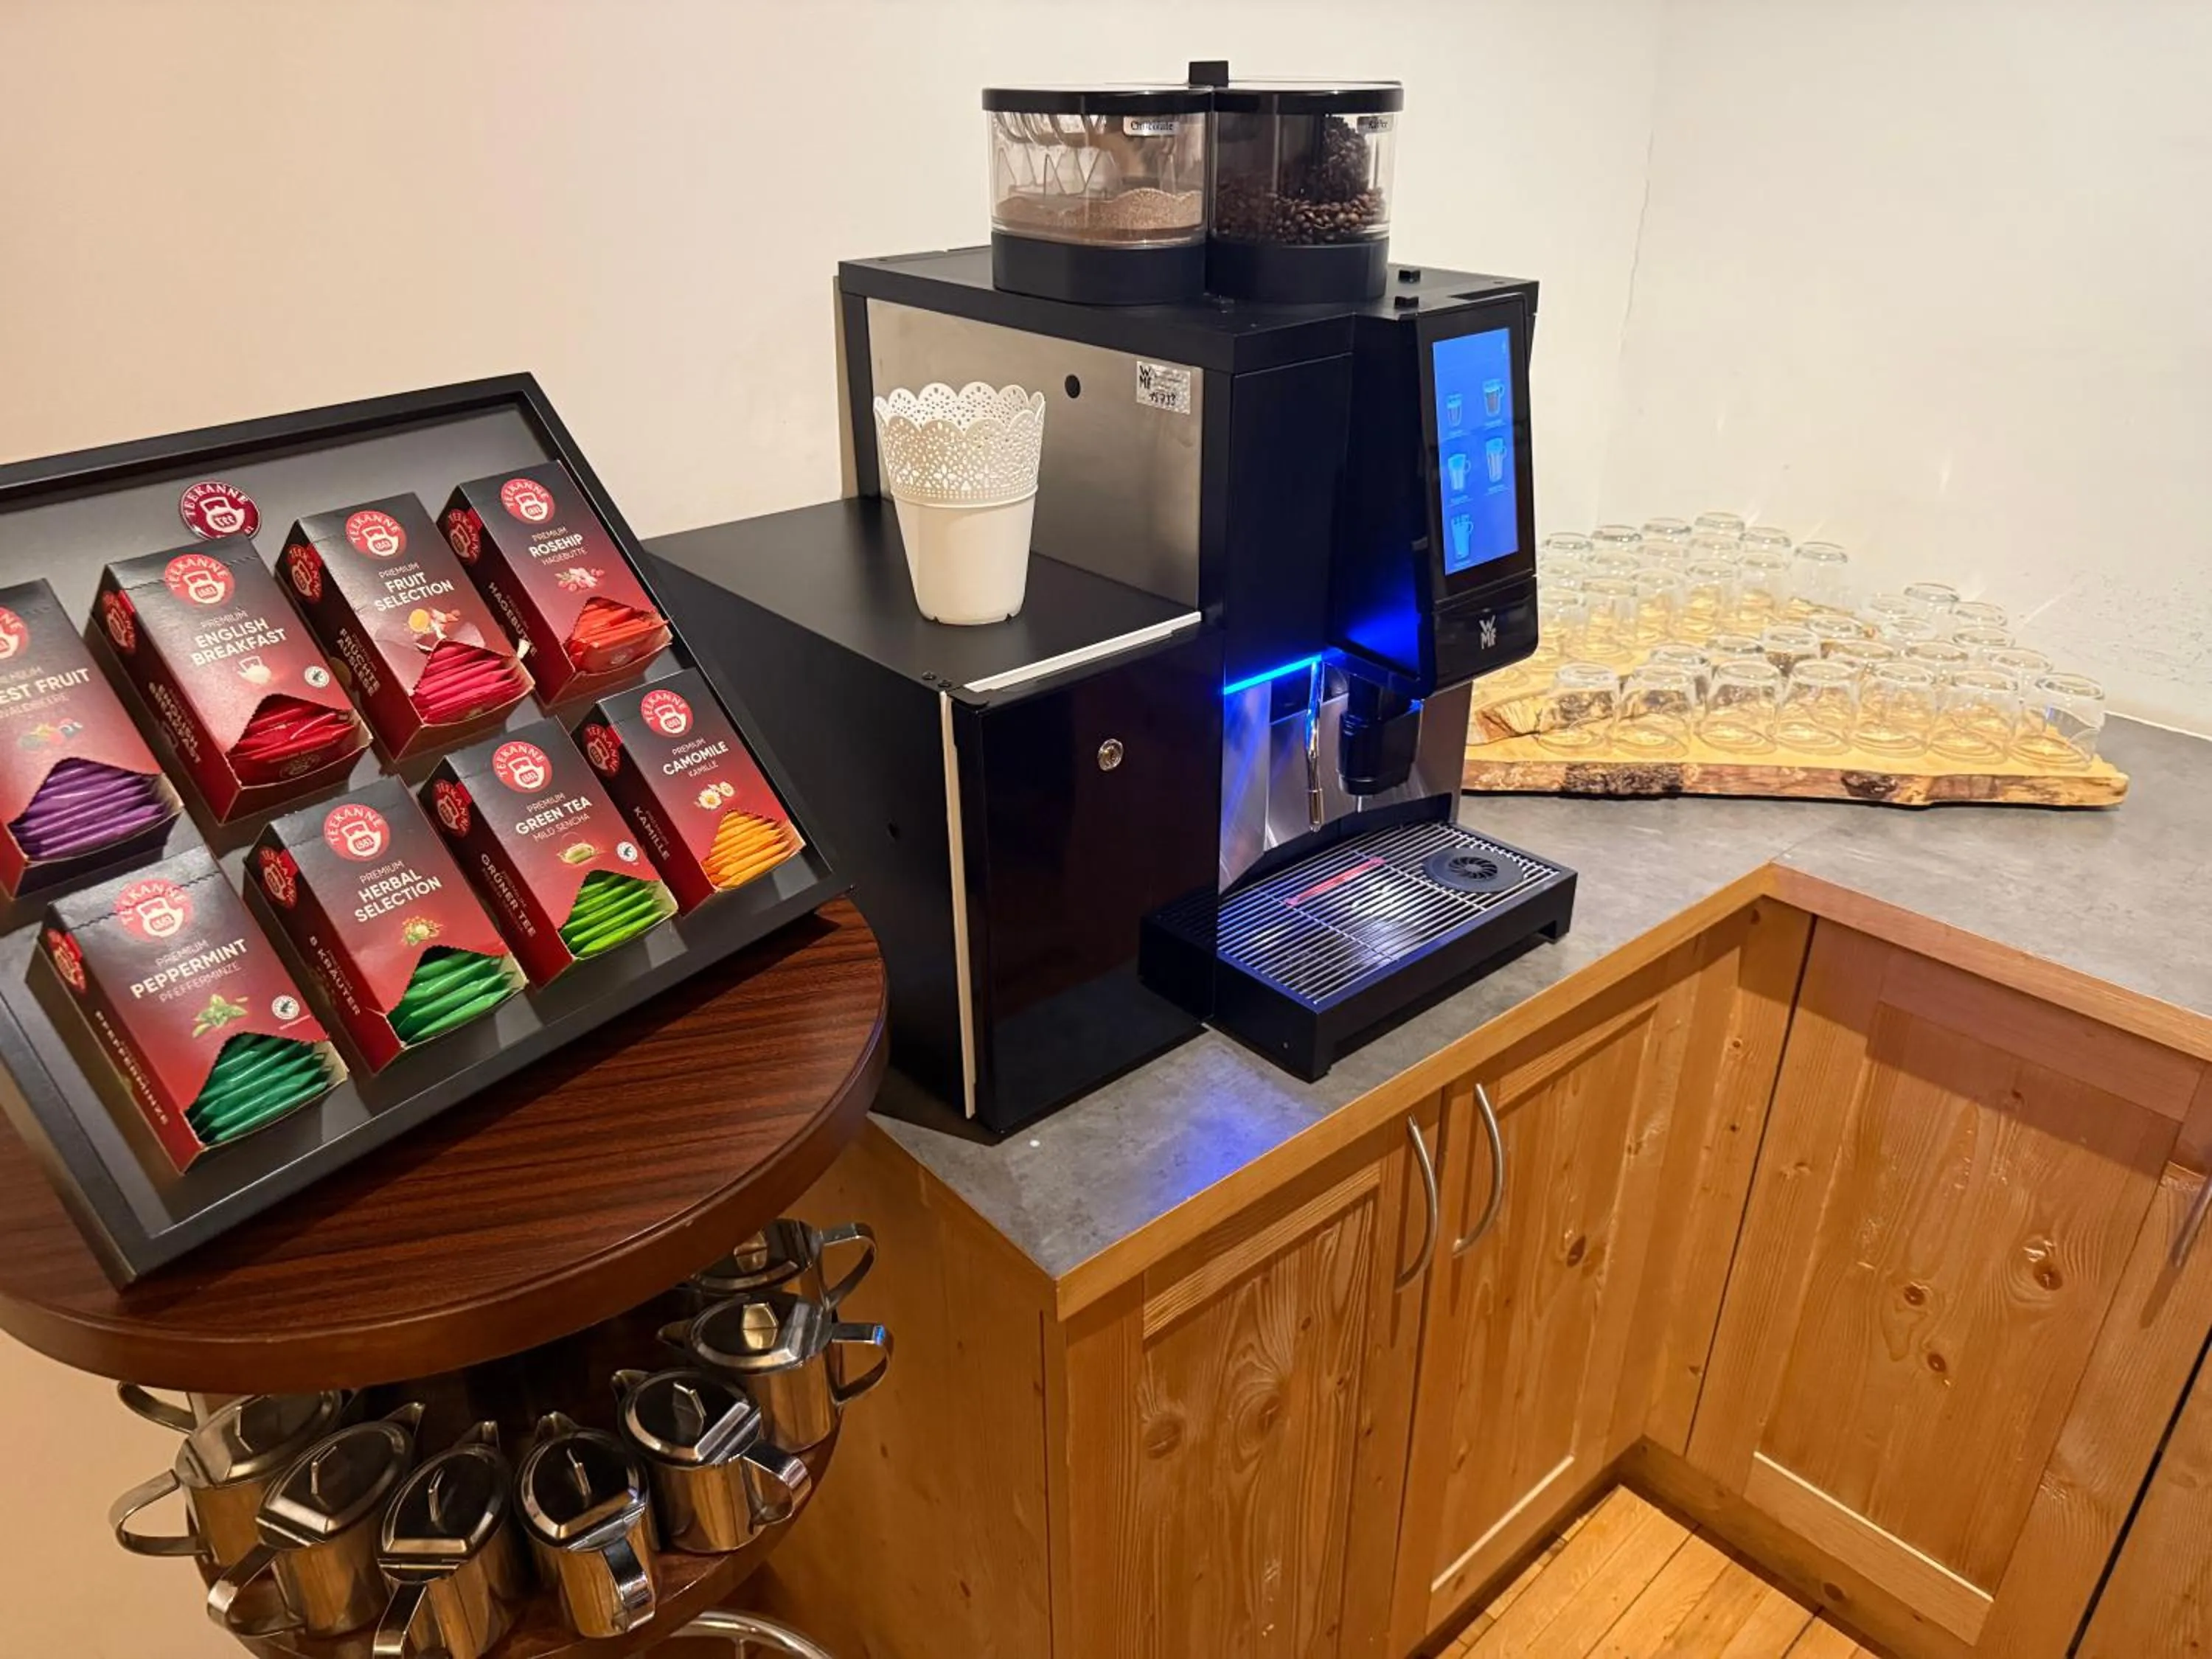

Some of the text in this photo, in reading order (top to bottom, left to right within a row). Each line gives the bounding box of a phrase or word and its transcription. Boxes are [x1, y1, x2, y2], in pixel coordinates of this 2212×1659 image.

[184, 484, 249, 517] TEEKANNE
[529, 534, 583, 558] ROSEHIP
[531, 526, 568, 542] PREMIUM
[378, 562, 420, 579] PREMIUM
[542, 548, 588, 566] HAGEBUTTE
[169, 557, 230, 590] TEEKANNE
[385, 572, 427, 594] FRUIT
[374, 580, 454, 612] SELECTION
[195, 617, 270, 648] ENGLISH
[201, 610, 249, 627] PREMIUM
[1479, 615, 1496, 649] WMF
[192, 628, 288, 667] BREAKFAST
[35, 668, 91, 694] FRUIT
[496, 743, 544, 777] TEEKANNE
[663, 741, 729, 775] CAMOMILE
[672, 737, 706, 755] PREMIUM
[688, 759, 719, 777] KAMILLE
[515, 796, 593, 835] GREEN TEA
[526, 793, 566, 813] PREMIUM
[327, 807, 385, 844] TEEKANNE
[532, 813, 590, 842] MILD SENCHA
[633, 805, 670, 860] KAMILLE
[358, 869, 422, 903] HERBAL
[359, 860, 405, 884] PREMIUM
[122, 883, 189, 925] TEEKANNE
[354, 876, 442, 923] SELECTION
[517, 910, 537, 937] TEE
[155, 938, 209, 967] PREMIUM
[129, 939, 248, 999] PEPPERMINT
[159, 960, 242, 1003] PFEFFERMINZE
